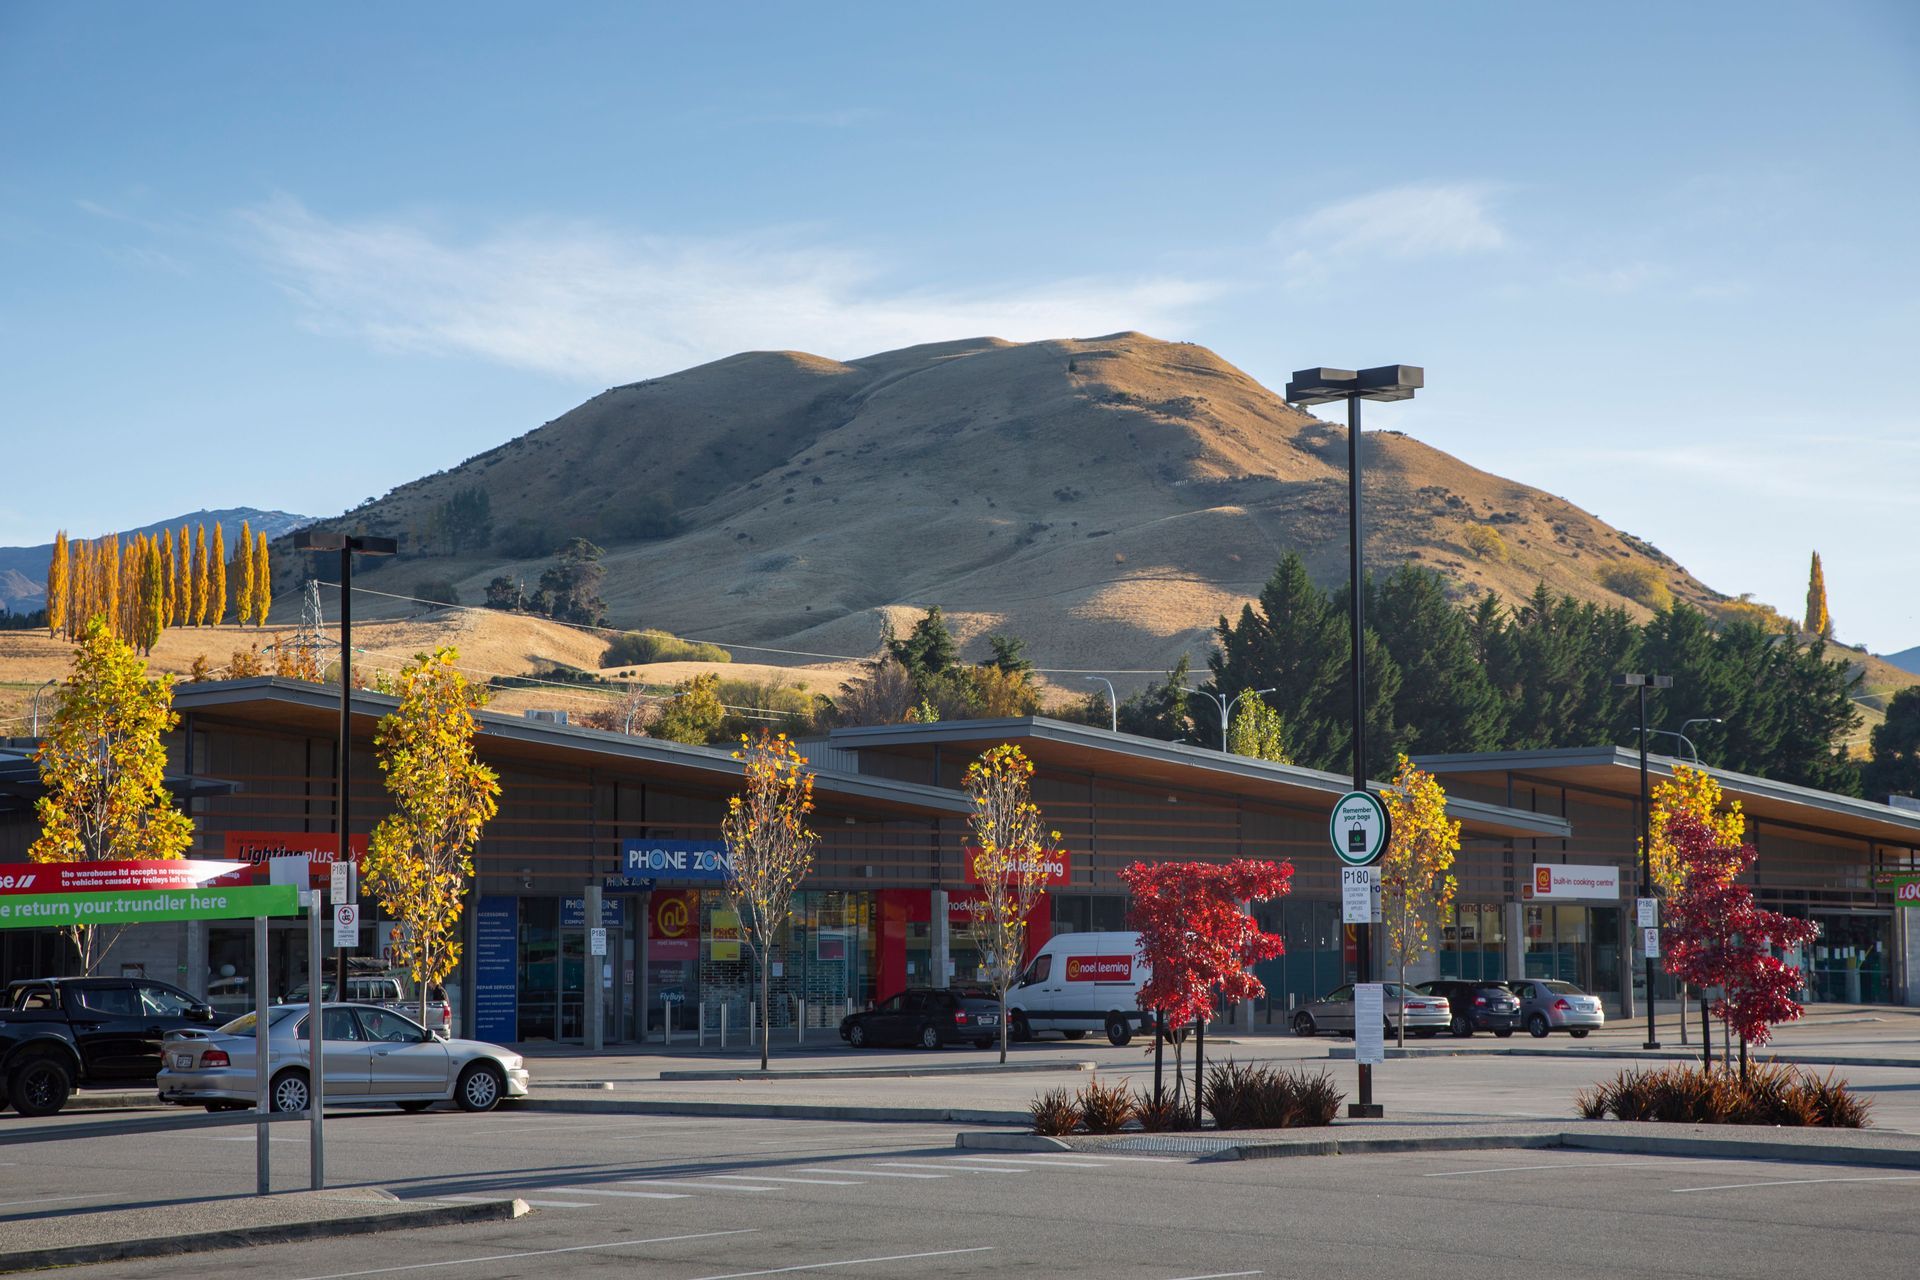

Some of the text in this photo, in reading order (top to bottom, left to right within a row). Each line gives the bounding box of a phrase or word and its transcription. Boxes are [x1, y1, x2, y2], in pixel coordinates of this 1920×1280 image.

[629, 849, 686, 870] PHONE
[62, 870, 74, 878] the
[76, 869, 117, 878] warehouse
[130, 868, 158, 876] accepts
[332, 864, 346, 876] P180
[62, 879, 70, 887] to
[72, 878, 103, 886] vehicles
[105, 876, 130, 886] caused
[132, 876, 141, 886] by
[142, 876, 168, 884] trolleys
[1344, 870, 1368, 884] P180
[1574, 878, 1595, 888] cooking
[15, 901, 70, 917] return
[74, 901, 114, 918] your
[116, 894, 186, 912] trundler
[190, 894, 226, 910] here
[1080, 962, 1097, 972] noel
[1098, 961, 1129, 975] leeming
[660, 992, 686, 1002] FlyBuys
